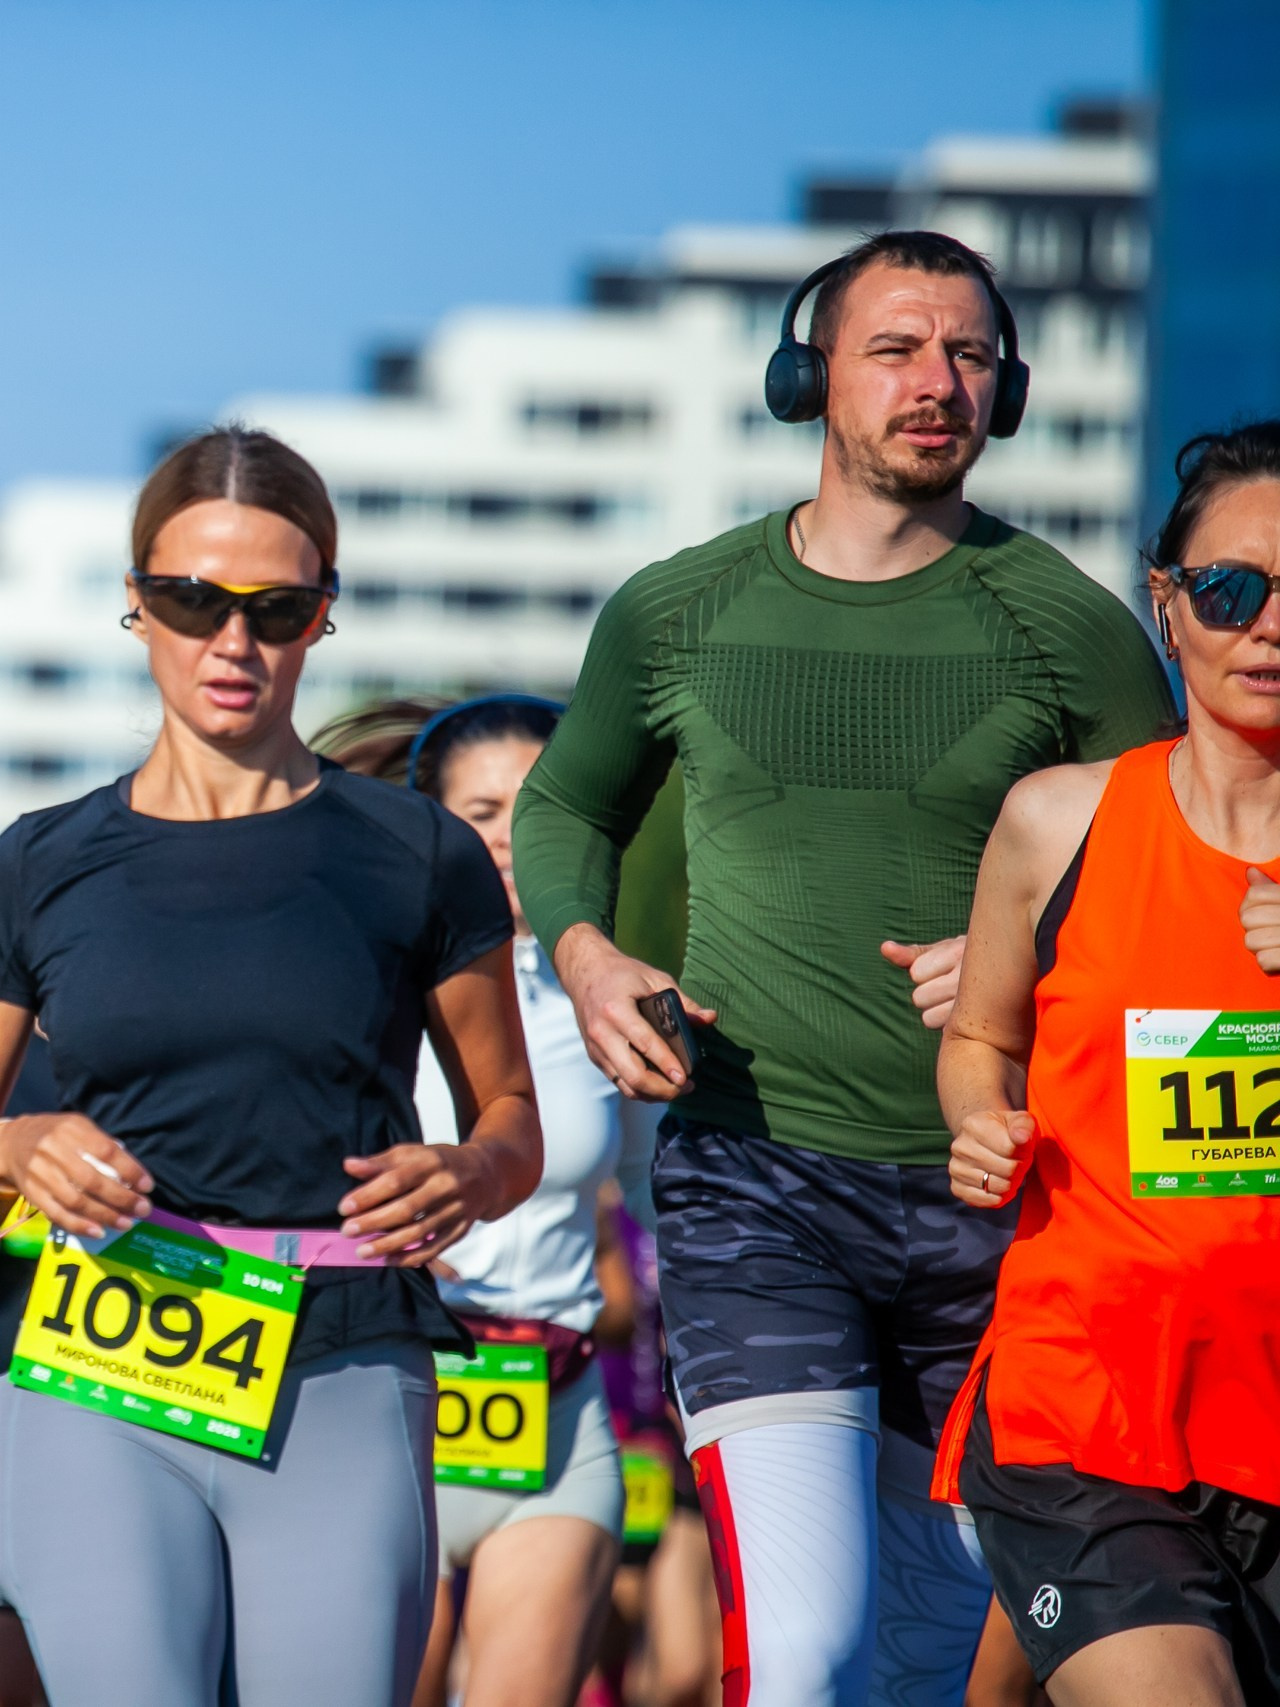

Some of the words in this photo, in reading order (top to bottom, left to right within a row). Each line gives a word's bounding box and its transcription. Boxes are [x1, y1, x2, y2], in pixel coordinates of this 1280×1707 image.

[1154, 1035, 1188, 1046] СБЕР
[1160, 1067, 1280, 1141] 112
[1191, 1146, 1276, 1161] ГУБАРЕВА
[242, 1272, 261, 1288] 10
[41, 1263, 265, 1390] 1094
[55, 1344, 139, 1382] МИРОНОВА
[143, 1372, 227, 1406] СВЕТЛАНА
